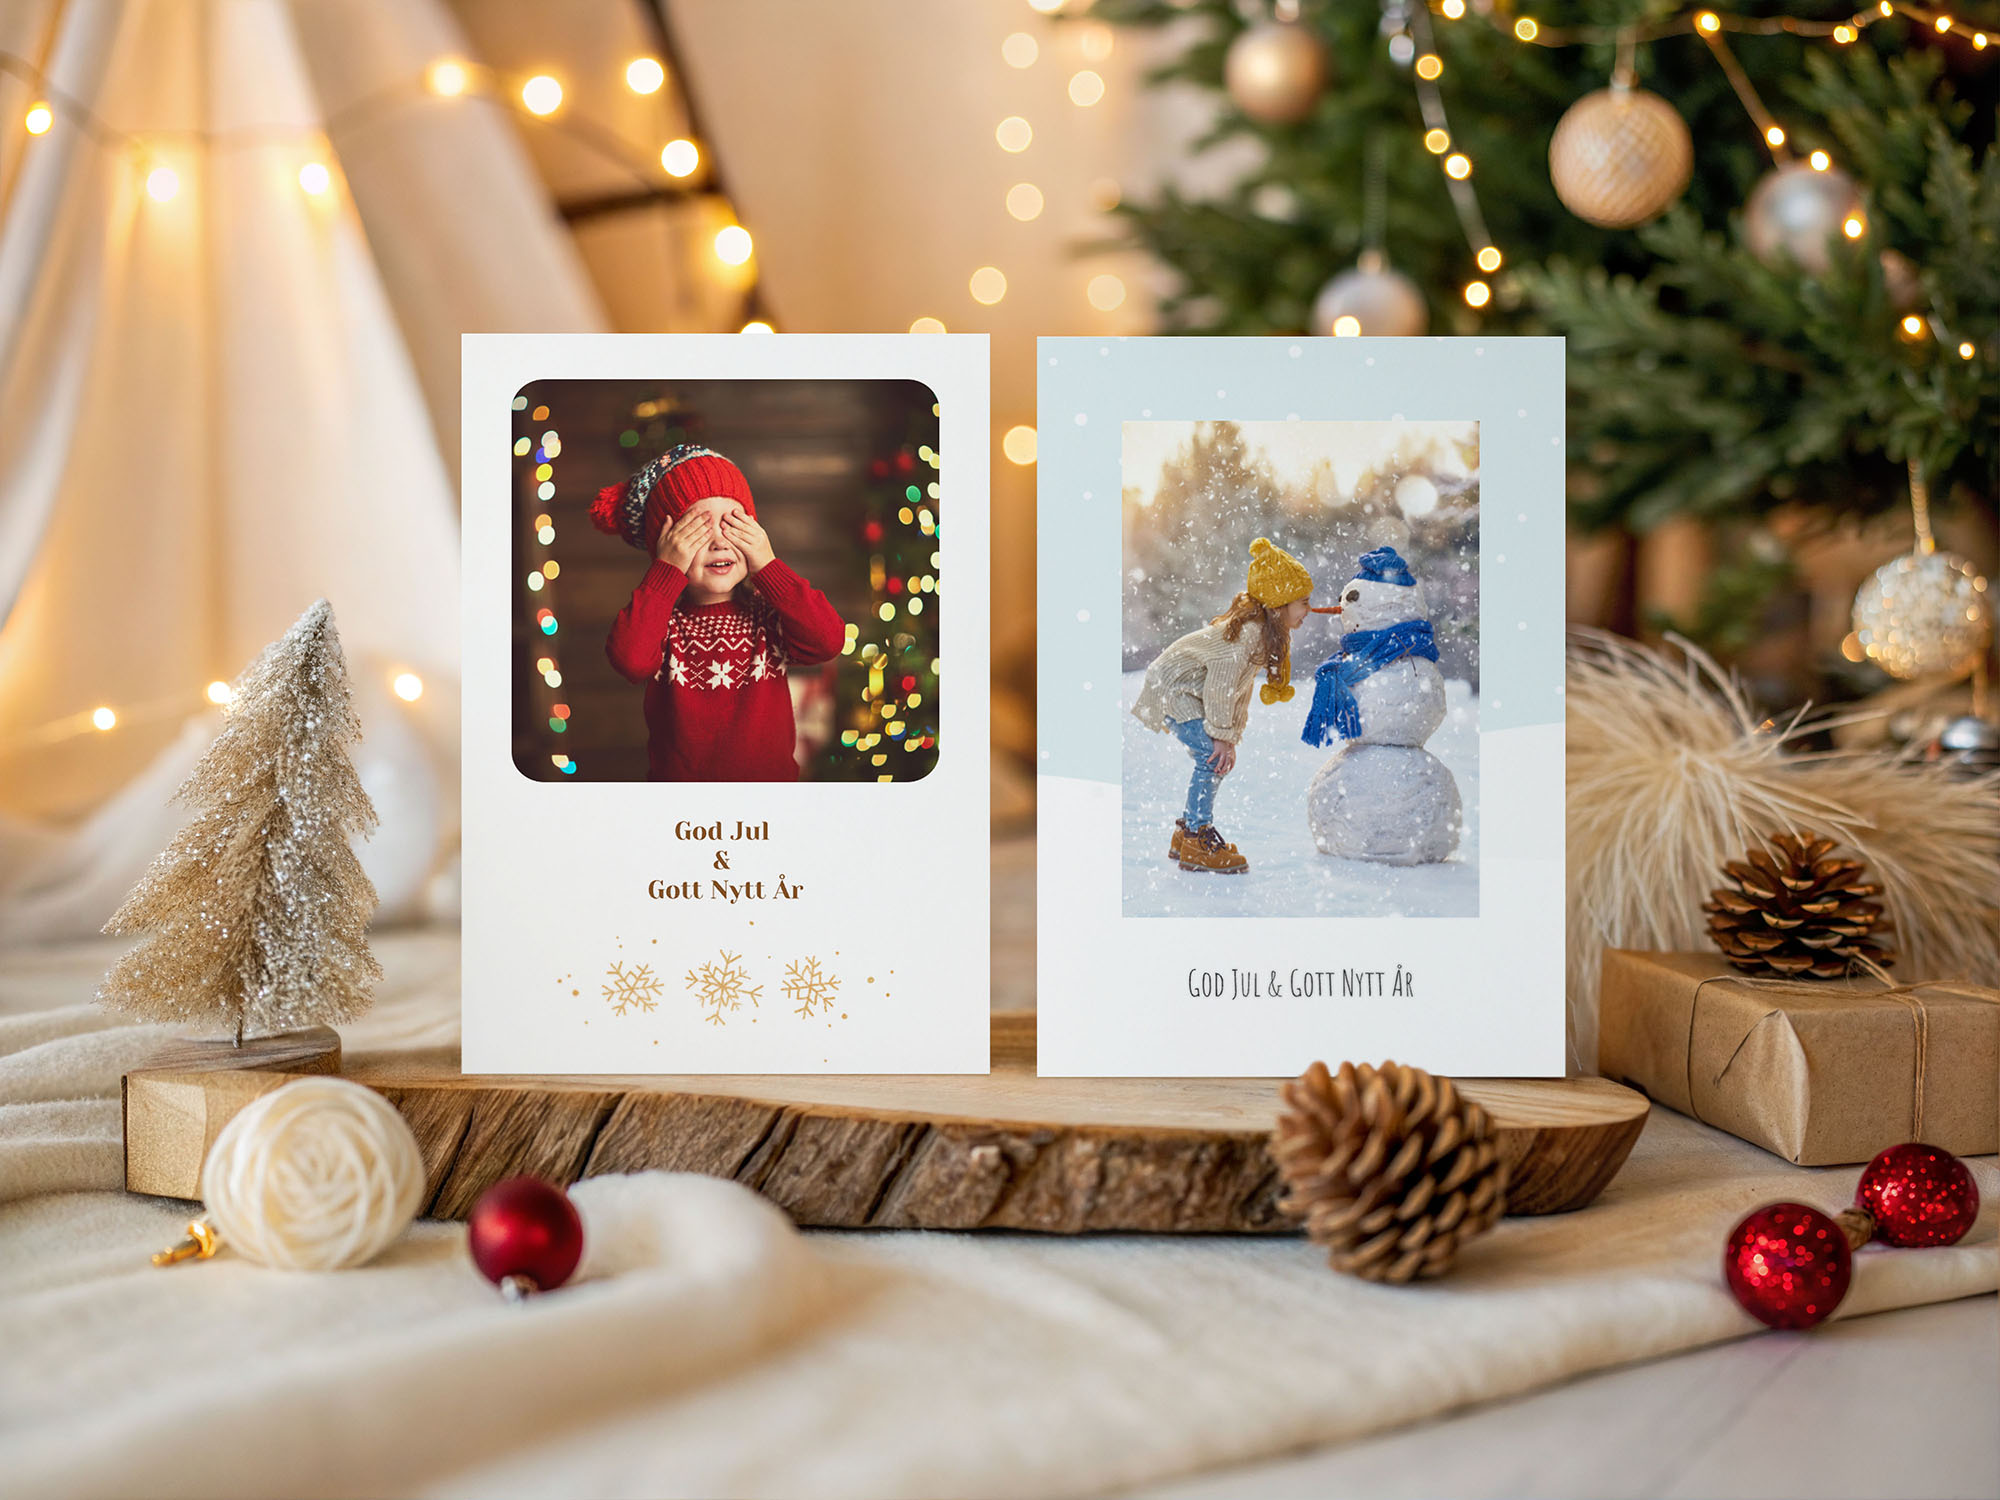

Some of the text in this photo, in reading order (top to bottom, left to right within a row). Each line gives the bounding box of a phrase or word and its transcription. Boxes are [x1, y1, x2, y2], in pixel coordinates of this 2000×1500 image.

[675, 820, 770, 841] God Jul
[713, 850, 731, 870] &
[648, 873, 804, 905] Gott Nytt År
[1267, 970, 1283, 998] &
